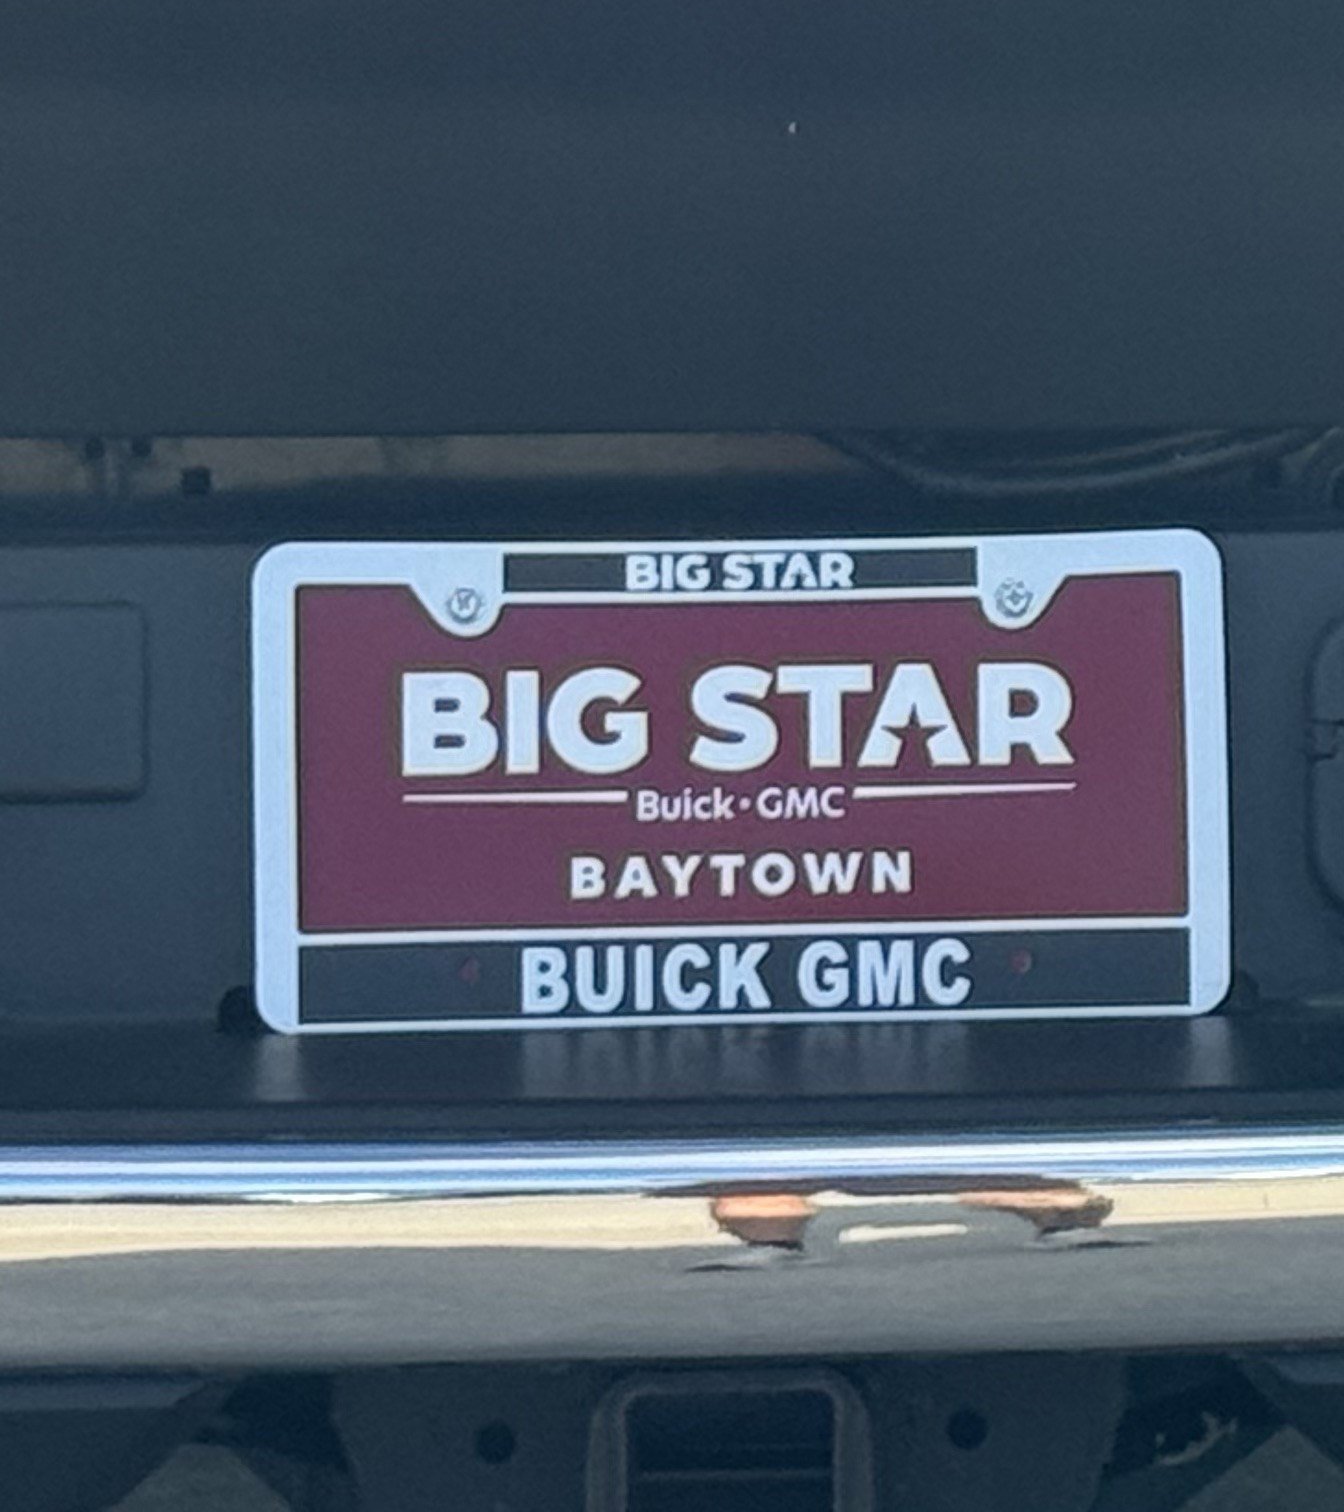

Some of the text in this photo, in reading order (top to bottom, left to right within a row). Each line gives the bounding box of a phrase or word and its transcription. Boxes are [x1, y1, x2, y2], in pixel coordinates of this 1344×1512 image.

[625, 552, 855, 591] BIG STAR
[401, 661, 1075, 776] BIG STAR
[636, 787, 846, 822] Buick GMC
[570, 851, 913, 900] BAYTOWN
[519, 939, 973, 1014] BUICK GMC
